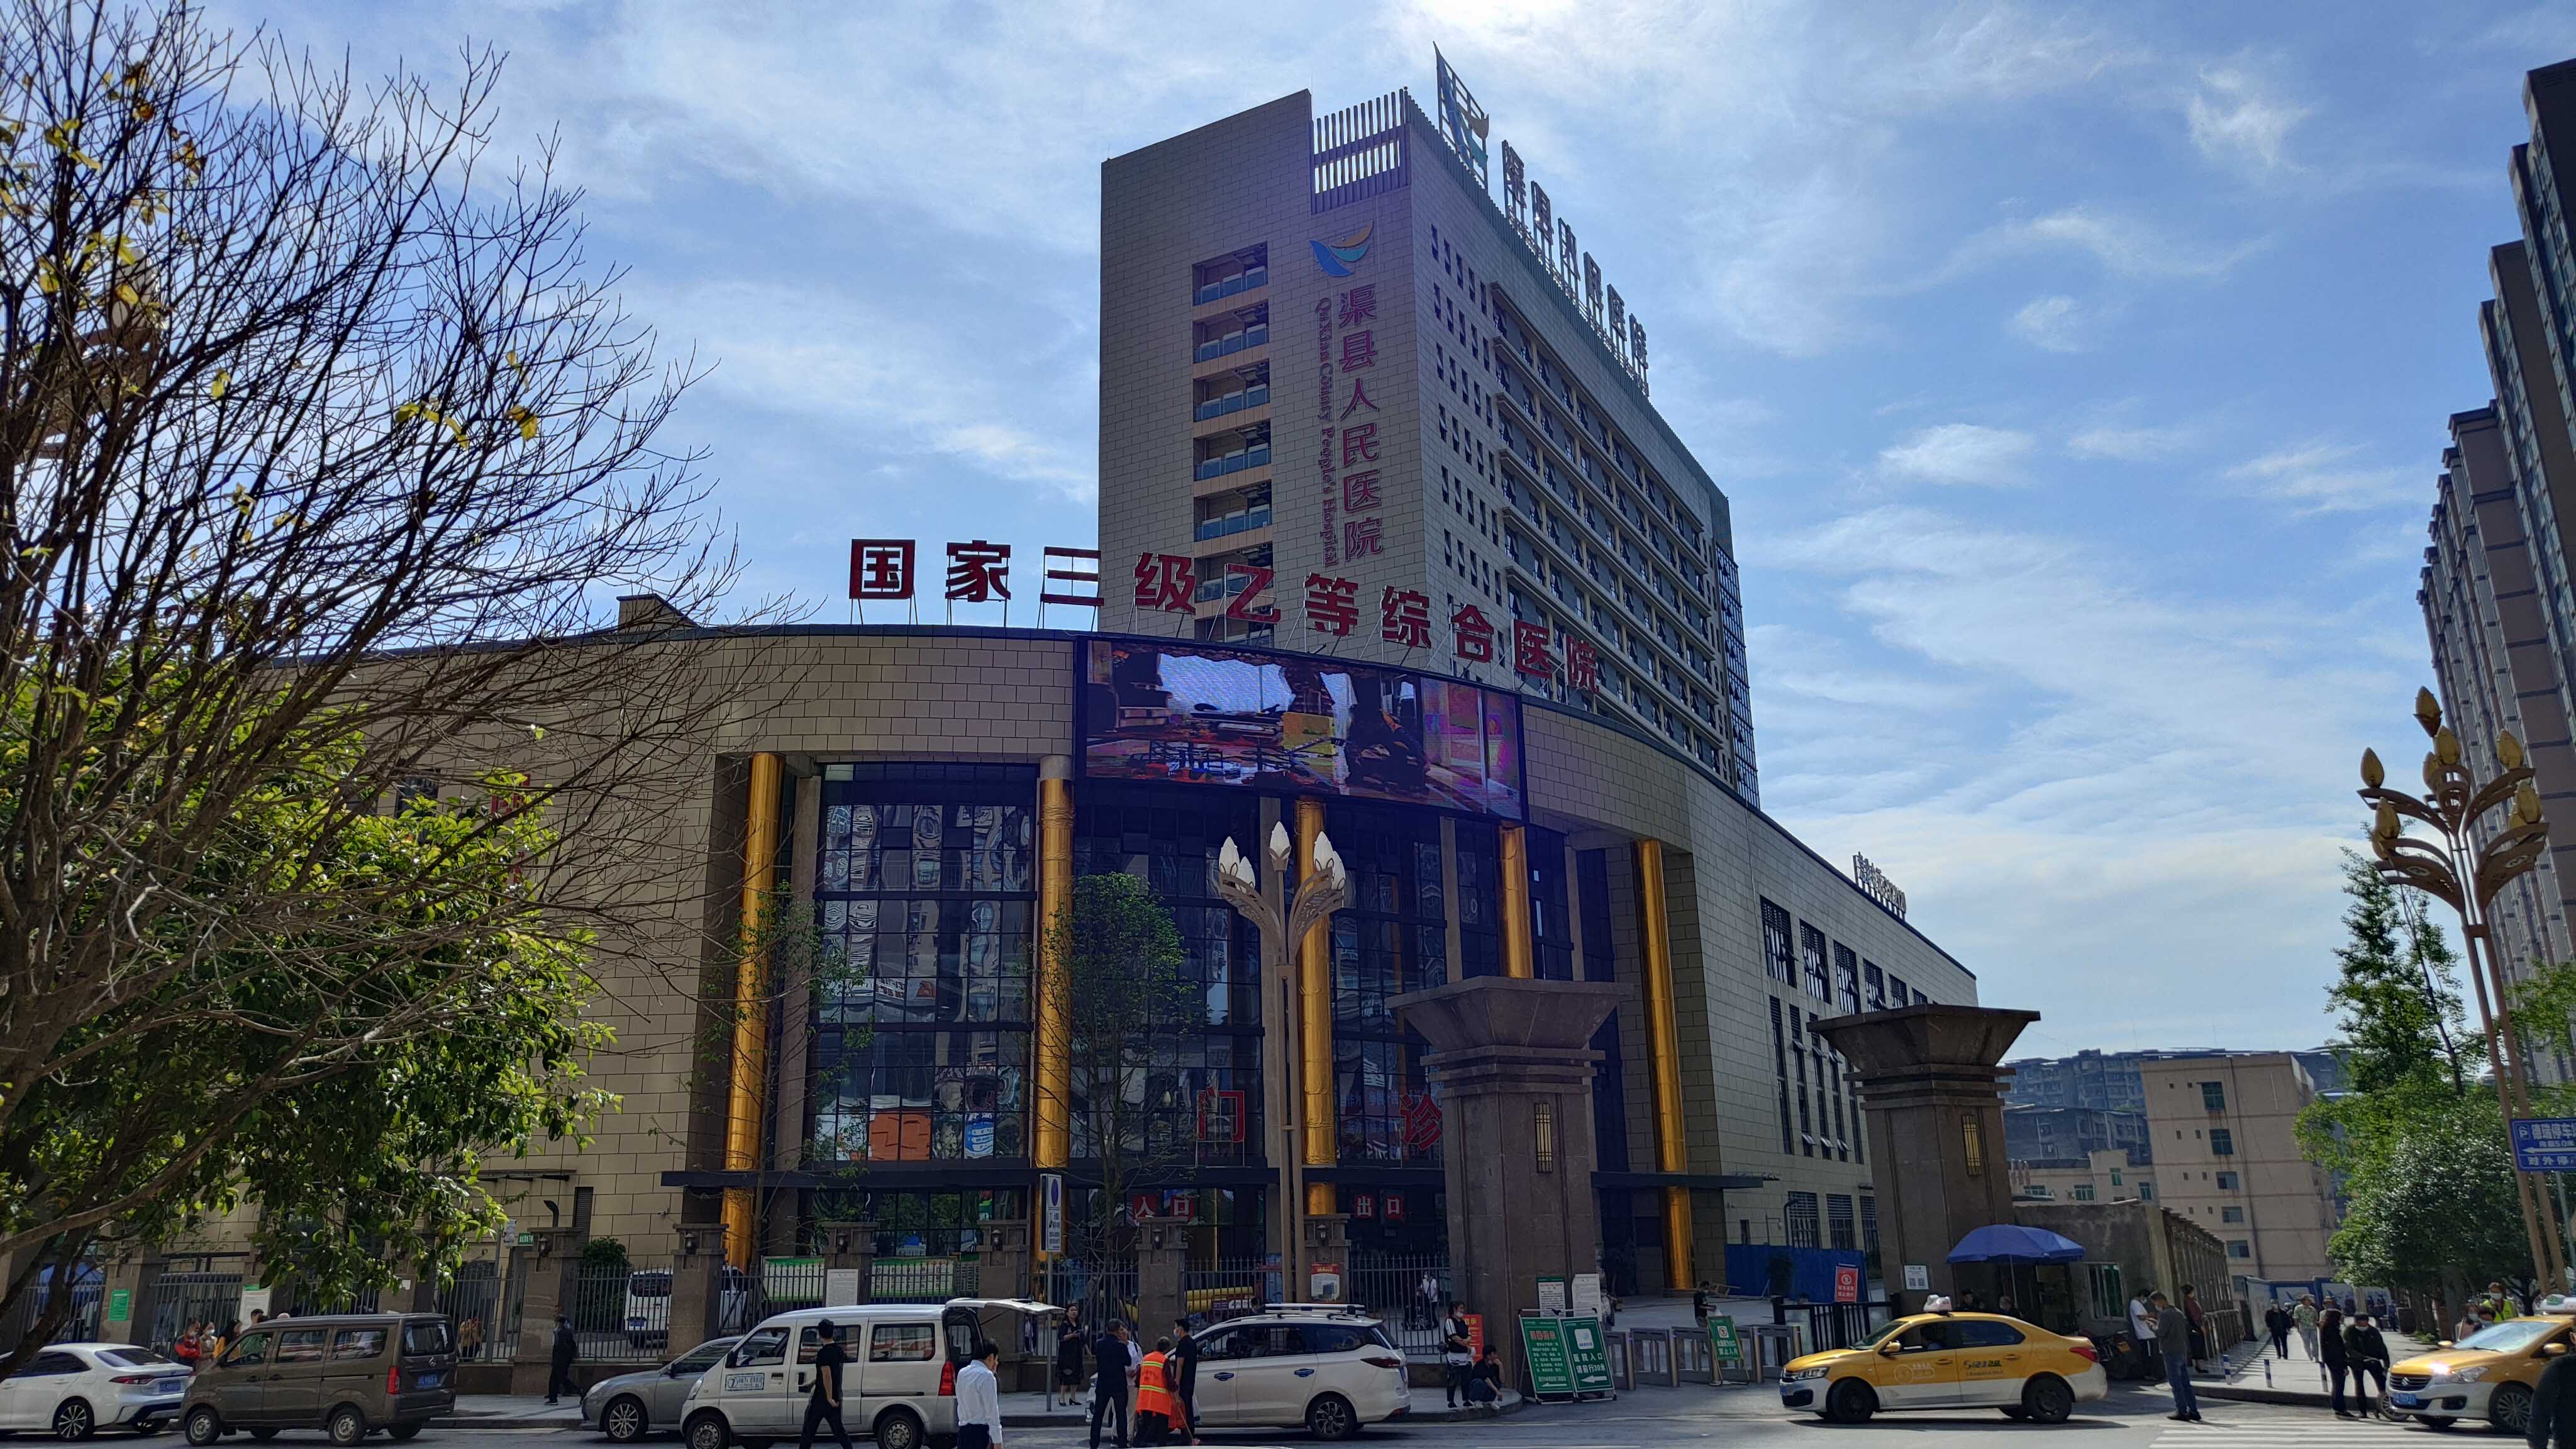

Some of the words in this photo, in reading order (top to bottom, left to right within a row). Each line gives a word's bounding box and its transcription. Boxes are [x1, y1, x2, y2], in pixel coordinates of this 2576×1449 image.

[1318, 363, 1333, 423] County
[1338, 283, 1383, 562] 渠县人民医院
[1318, 426, 1336, 494] People's
[1320, 497, 1339, 568] Hospital
[849, 538, 1600, 695] 国家三级乙等综合医院
[1136, 1196, 1190, 1216] 入口
[1357, 1196, 1401, 1217] 出口
[1573, 1353, 1603, 1362] 医院入口
